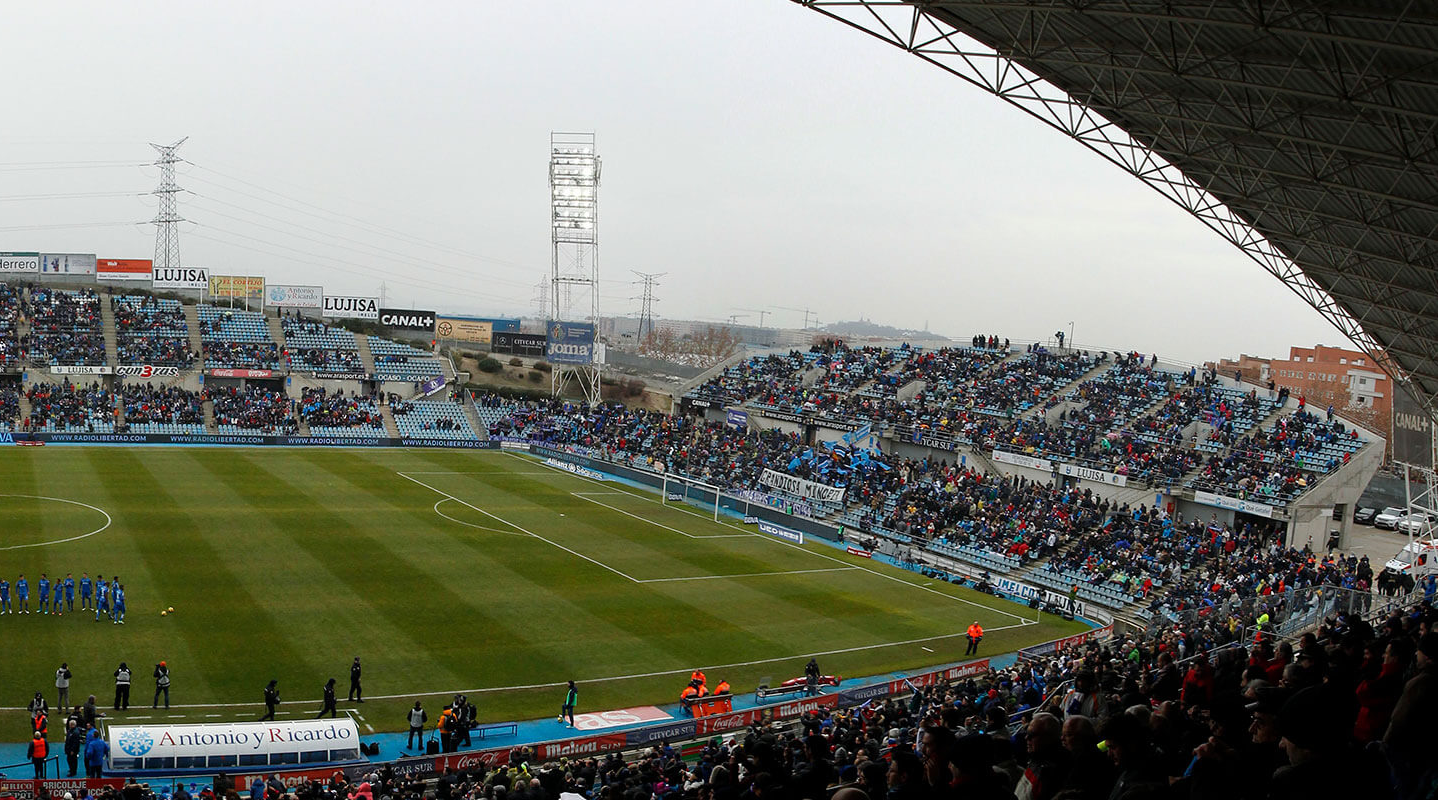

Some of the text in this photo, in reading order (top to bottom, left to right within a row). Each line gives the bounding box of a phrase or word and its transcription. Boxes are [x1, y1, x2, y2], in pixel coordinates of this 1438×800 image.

[154, 269, 207, 282] LUJISA
[324, 298, 377, 312] LUJISA
[381, 314, 434, 330] CANAL+
[67, 366, 93, 374] LUJISA
[765, 411, 802, 423] www.arasport.es
[1395, 413, 1429, 432] CANAL+
[814, 420, 853, 431] www.arasport.es
[170, 436, 264, 444] WWW.RADIOLIBERTAD.COM
[288, 438, 379, 446] WWW.RADIOLIBERTAD.COM
[402, 439, 490, 448] WWW.RADIOLIBERTAD.COM
[1076, 468, 1105, 482] LUJISA
[780, 702, 818, 717] Mahou
[713, 713, 745, 731] Coca-Cola
[159, 725, 351, 749] Antonio y Ricardo
[649, 728, 680, 741] CITYCAR
[546, 742, 597, 757] Mahou
[415, 763, 433, 772] SUR
[43, 781, 87, 789] BRICOLAJE
[244, 774, 308, 790] Mhou
